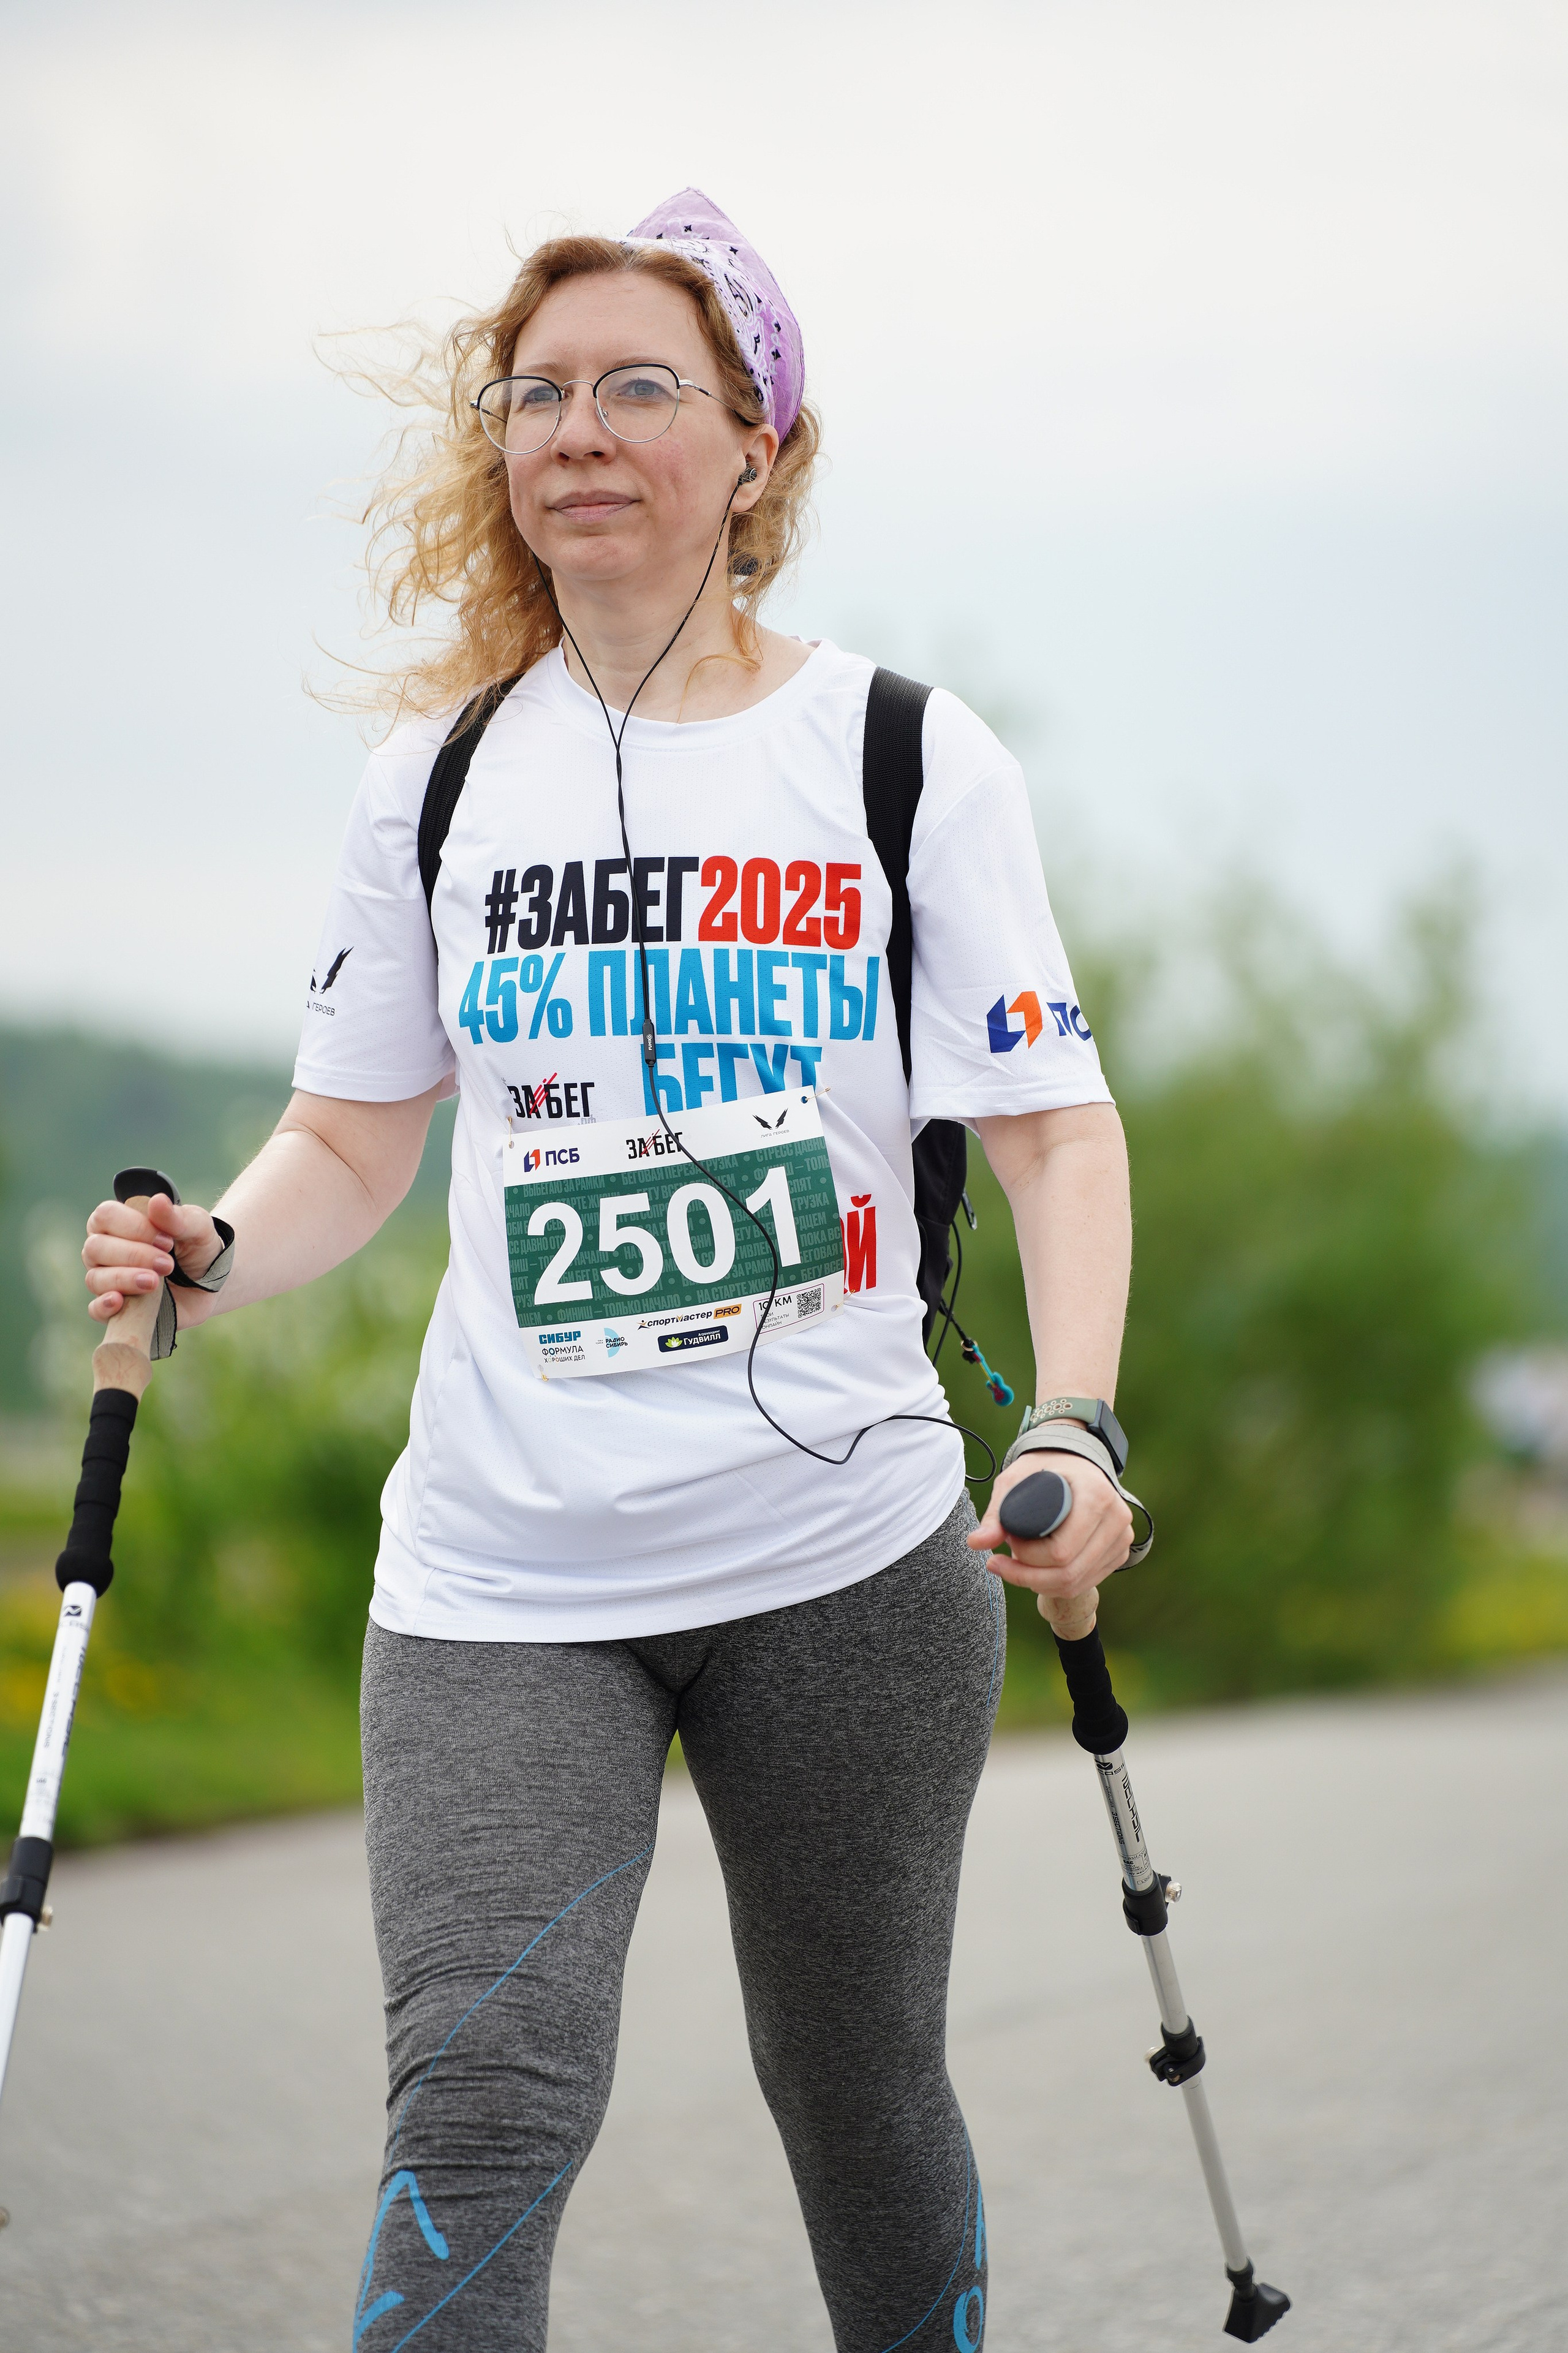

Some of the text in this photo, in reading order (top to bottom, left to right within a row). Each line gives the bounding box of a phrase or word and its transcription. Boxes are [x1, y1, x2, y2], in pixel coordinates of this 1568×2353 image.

[484, 856, 862, 954] #ЗАБЕГ2025
[458, 949, 880, 1045] 45% ПЛАНЕТЫ
[312, 1003, 335, 1016] ГЕРОЕВ
[545, 1147, 580, 1166] ПСБ
[527, 1165, 802, 1305] 2501
[715, 1305, 740, 1318] PRO
[764, 1313, 790, 1324] ЕЗУЛЬТАТЫ
[538, 1331, 581, 1345] СИБУР
[542, 1345, 584, 1356] ФОРМУЛА
